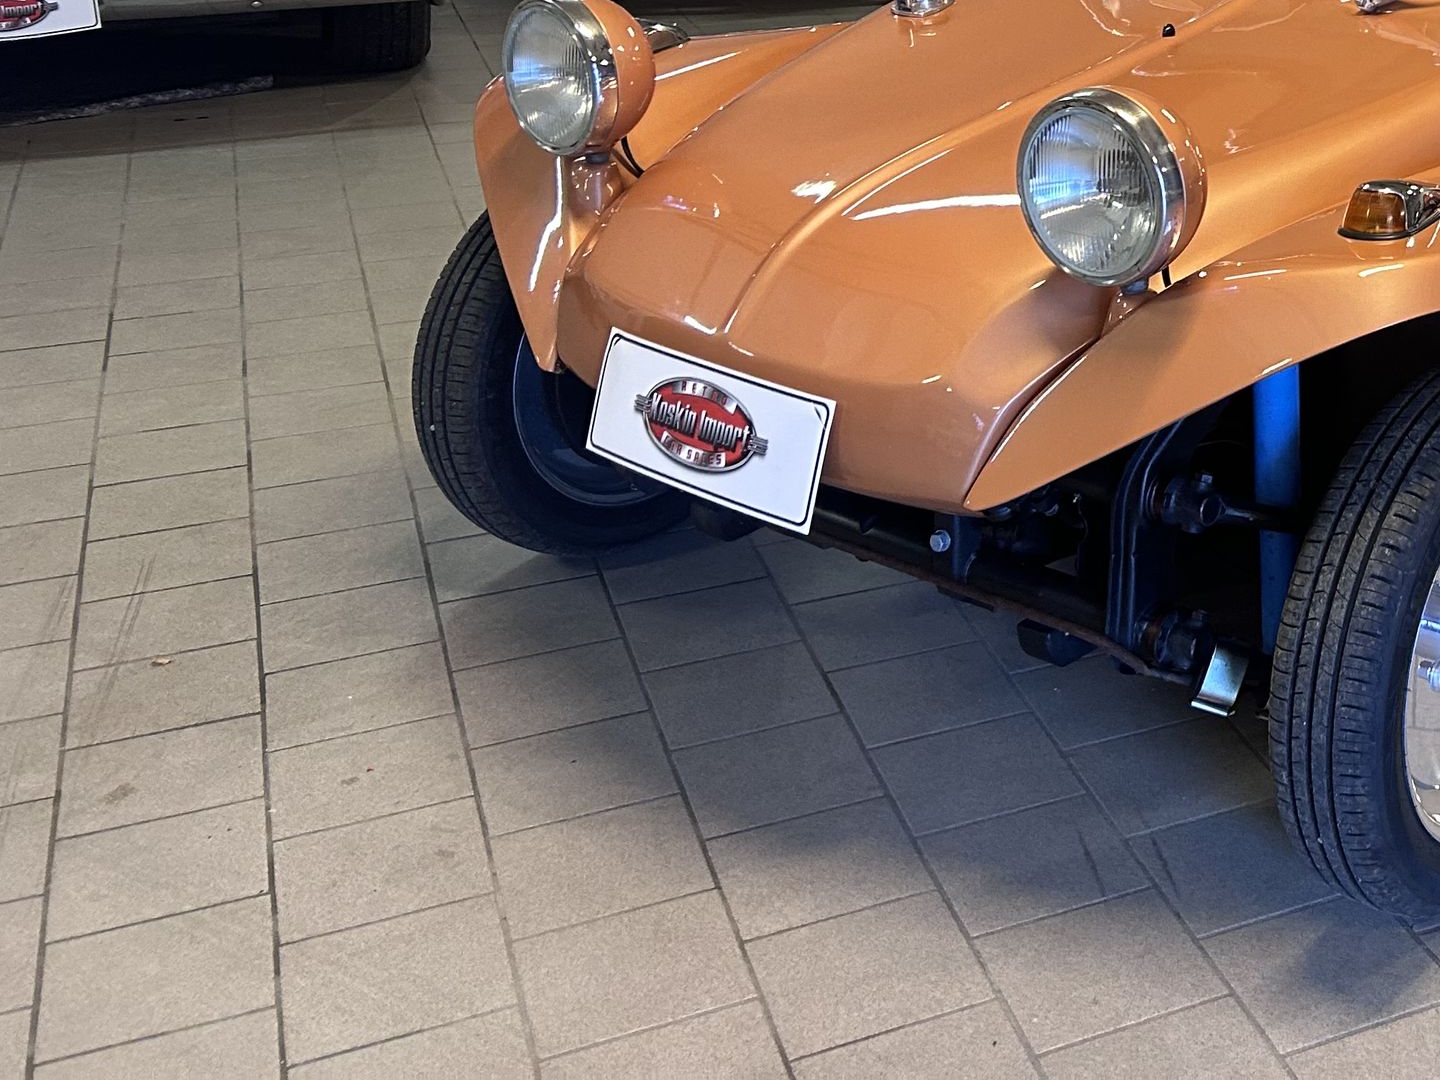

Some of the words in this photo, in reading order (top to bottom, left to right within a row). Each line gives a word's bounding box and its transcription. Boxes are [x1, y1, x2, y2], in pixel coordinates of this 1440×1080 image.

[681, 380, 729, 406] RETRO
[650, 392, 697, 438] Koskin
[698, 410, 750, 454] Import
[664, 435, 683, 456] CAR
[686, 449, 723, 465] SALES
